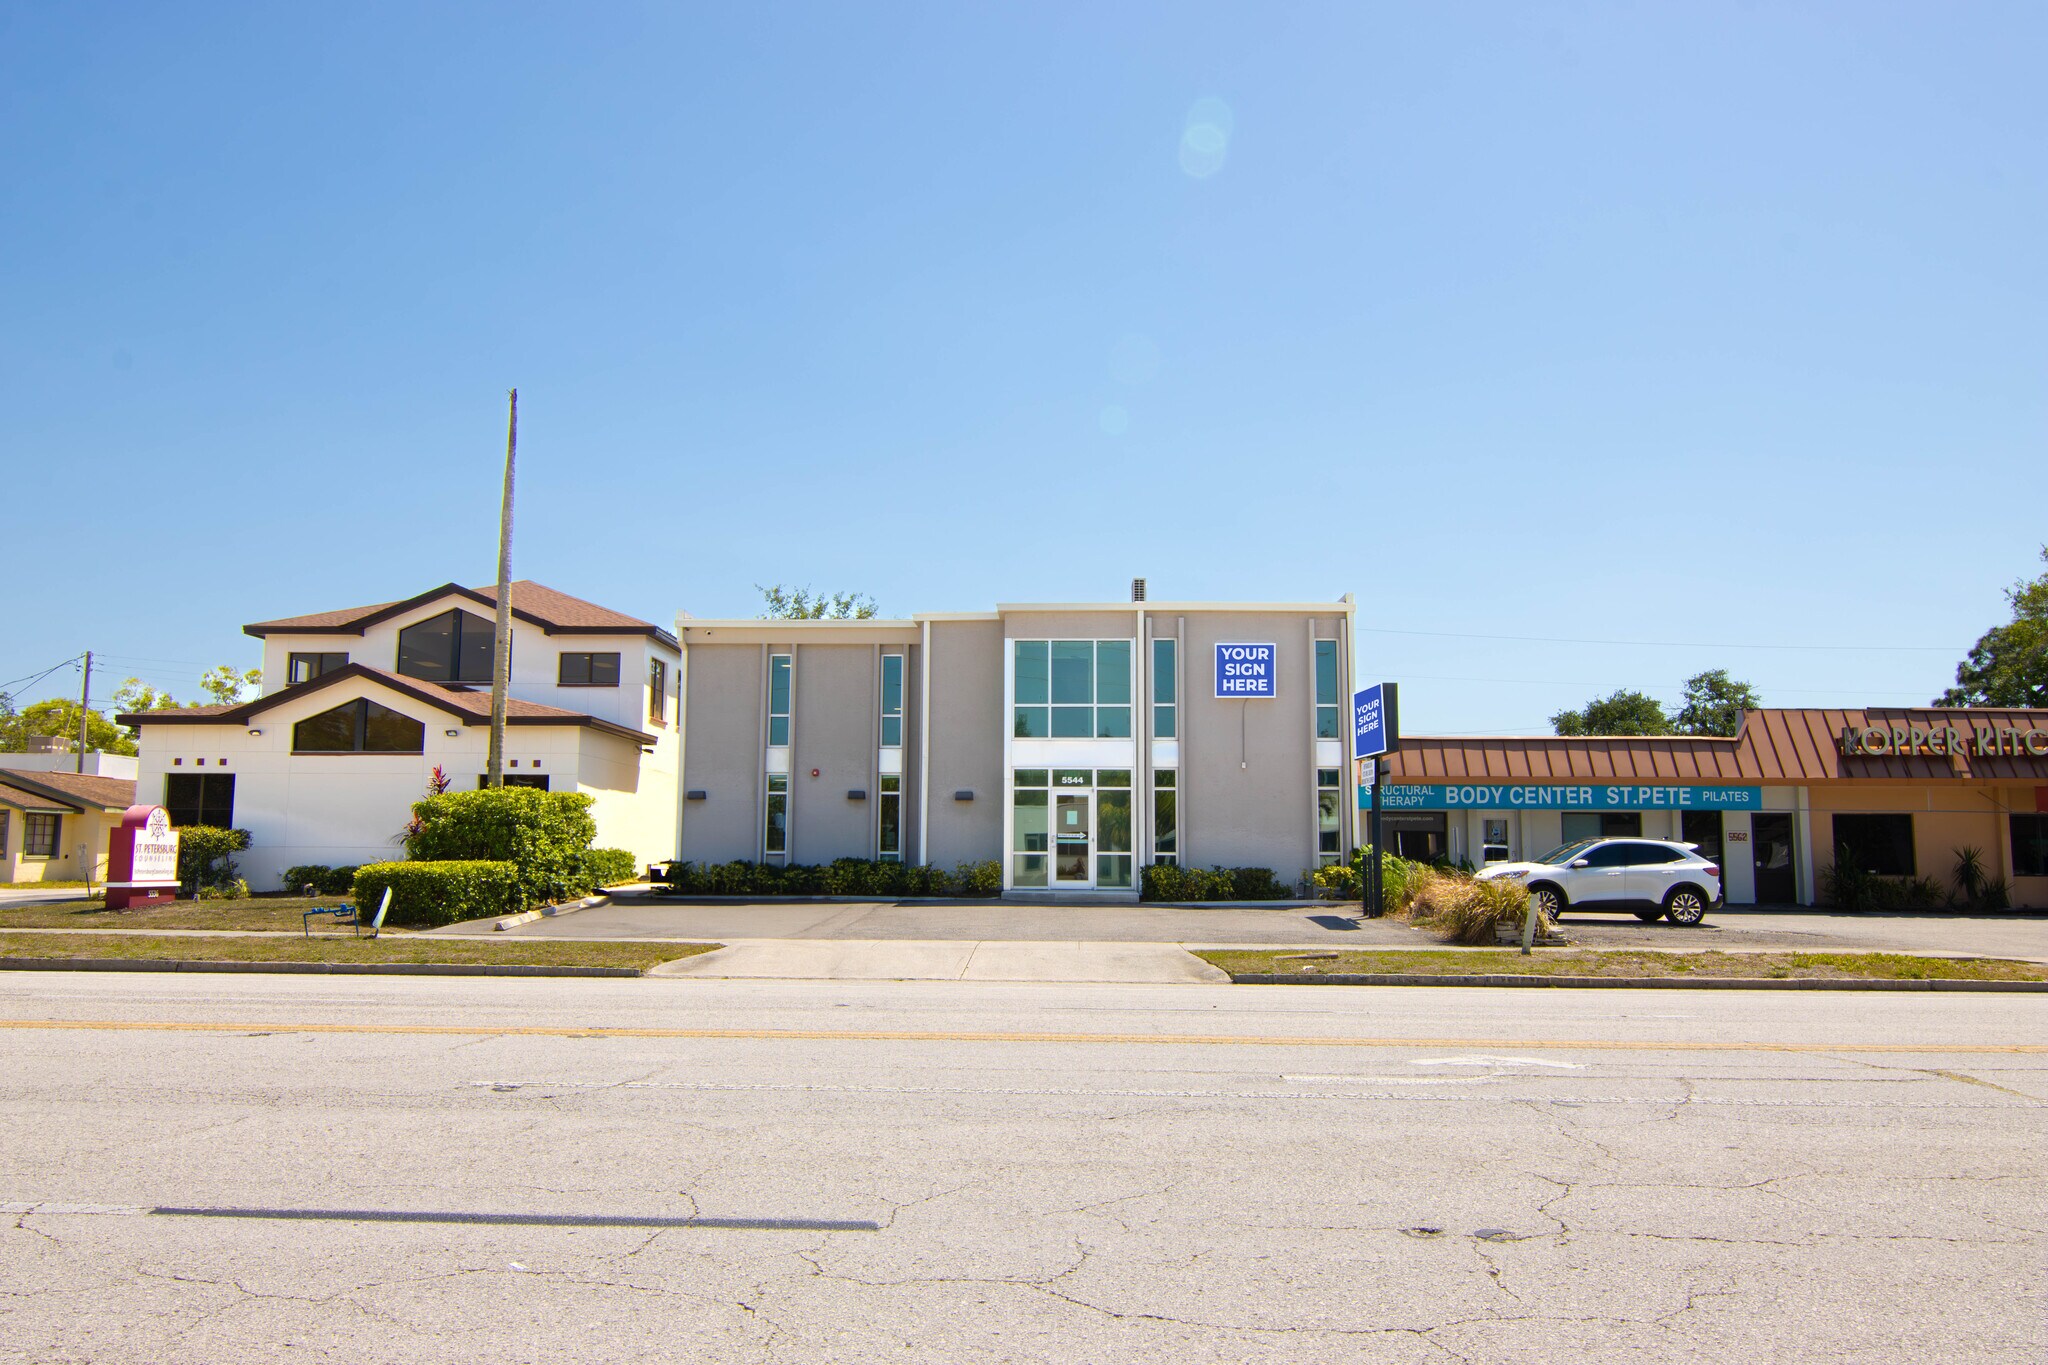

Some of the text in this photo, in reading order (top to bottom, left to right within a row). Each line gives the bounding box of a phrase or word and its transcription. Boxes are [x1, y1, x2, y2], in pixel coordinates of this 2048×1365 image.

[1221, 647, 1269, 660] YOUR
[1225, 663, 1265, 676] SIGN
[1222, 679, 1268, 691] HERE
[1356, 699, 1380, 715] YOUR
[1358, 709, 1378, 726] SIGN
[1357, 719, 1380, 737] HERE
[1841, 726, 1965, 756] KOPPER
[1061, 776, 1084, 784] 5544
[1365, 785, 1435, 796] SRUCTURAL
[1446, 786, 1749, 805] BODY CENTER ST.PETE PILATES
[1380, 796, 1425, 806] HERAPY
[1728, 832, 1748, 841] 5562
[144, 843, 177, 854] PETERSBURG
[134, 855, 176, 863] COUNSELING
